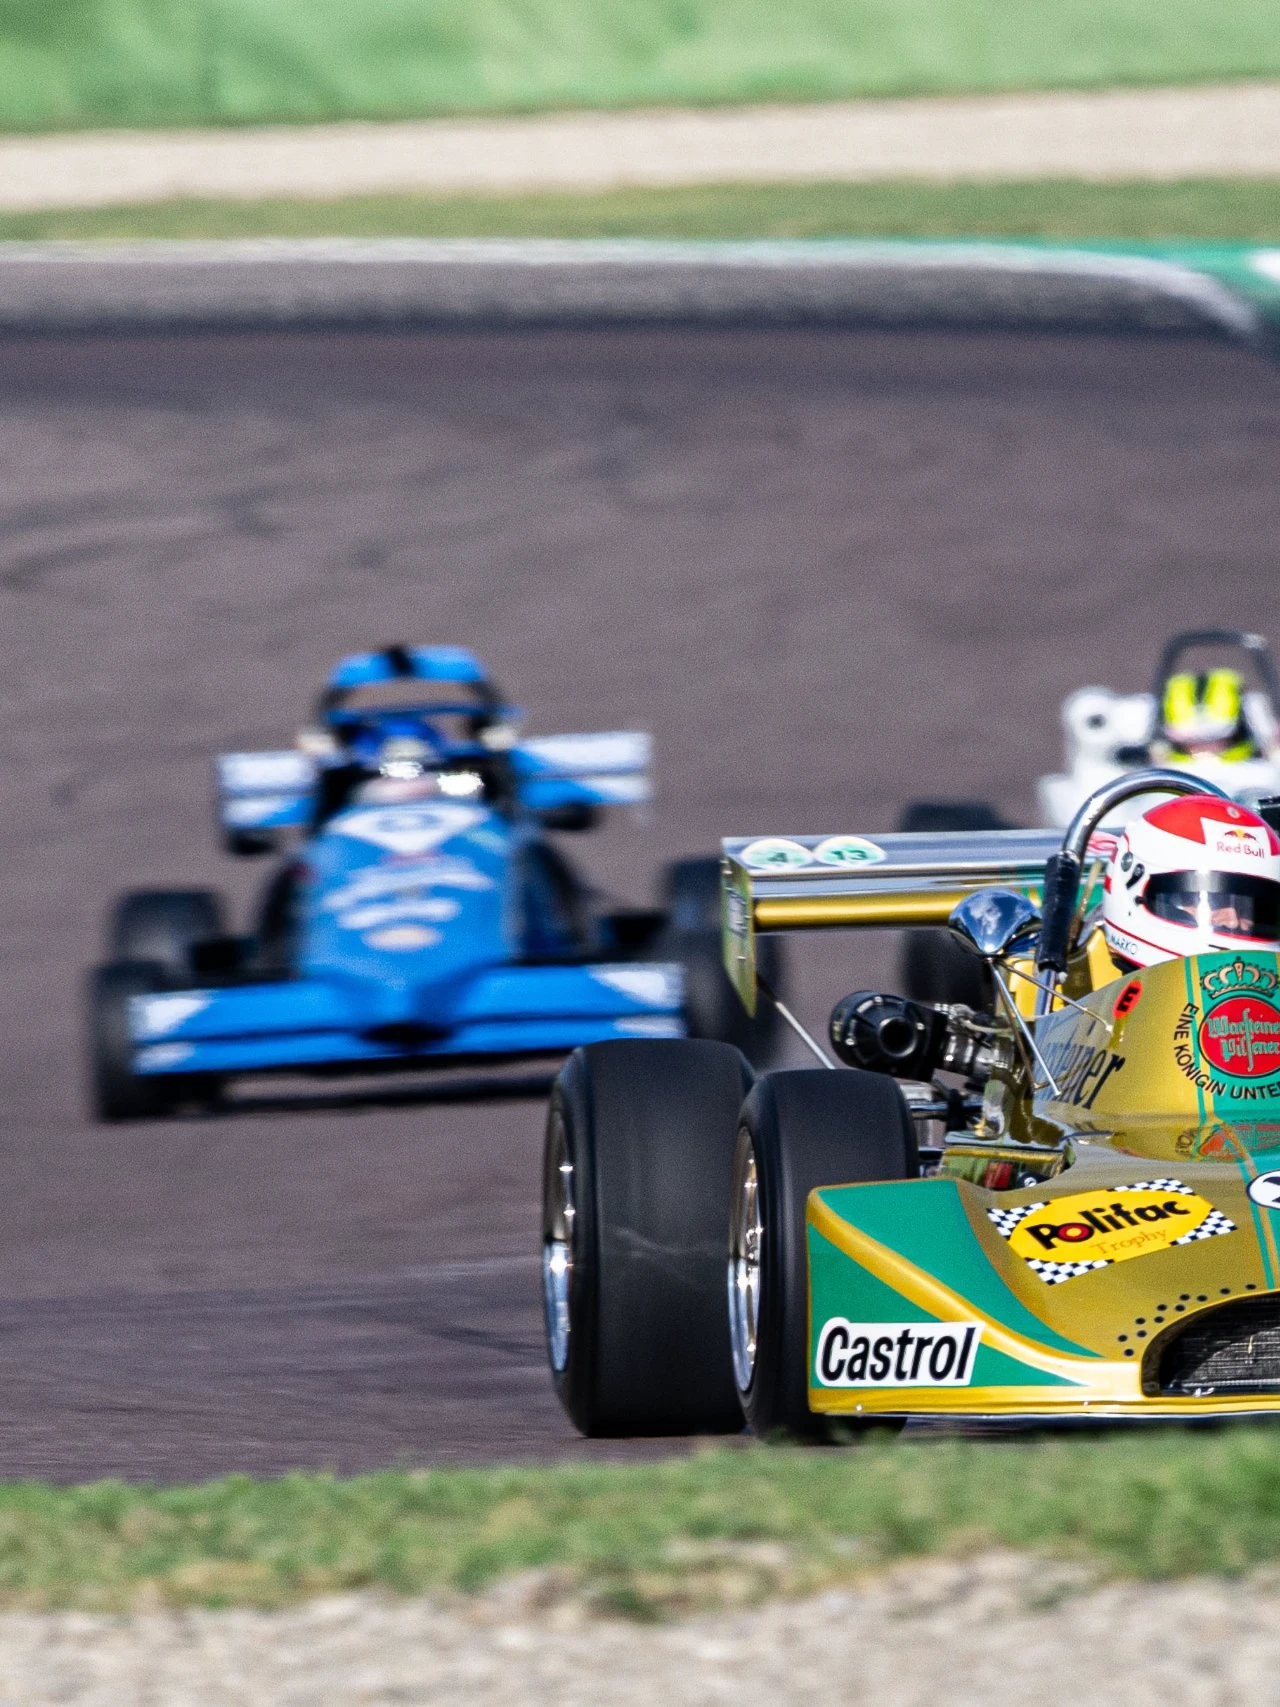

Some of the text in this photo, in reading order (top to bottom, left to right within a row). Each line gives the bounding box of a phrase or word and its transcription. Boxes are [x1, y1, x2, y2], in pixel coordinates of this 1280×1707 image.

[831, 849, 869, 861] 13
[1216, 841, 1265, 859] Red Bull
[1116, 987, 1140, 1012] E
[1174, 1002, 1200, 1041] EINE
[1024, 1199, 1191, 1250] Polifac
[1090, 1228, 1168, 1255] Trophy
[821, 1325, 977, 1381] Castrol
